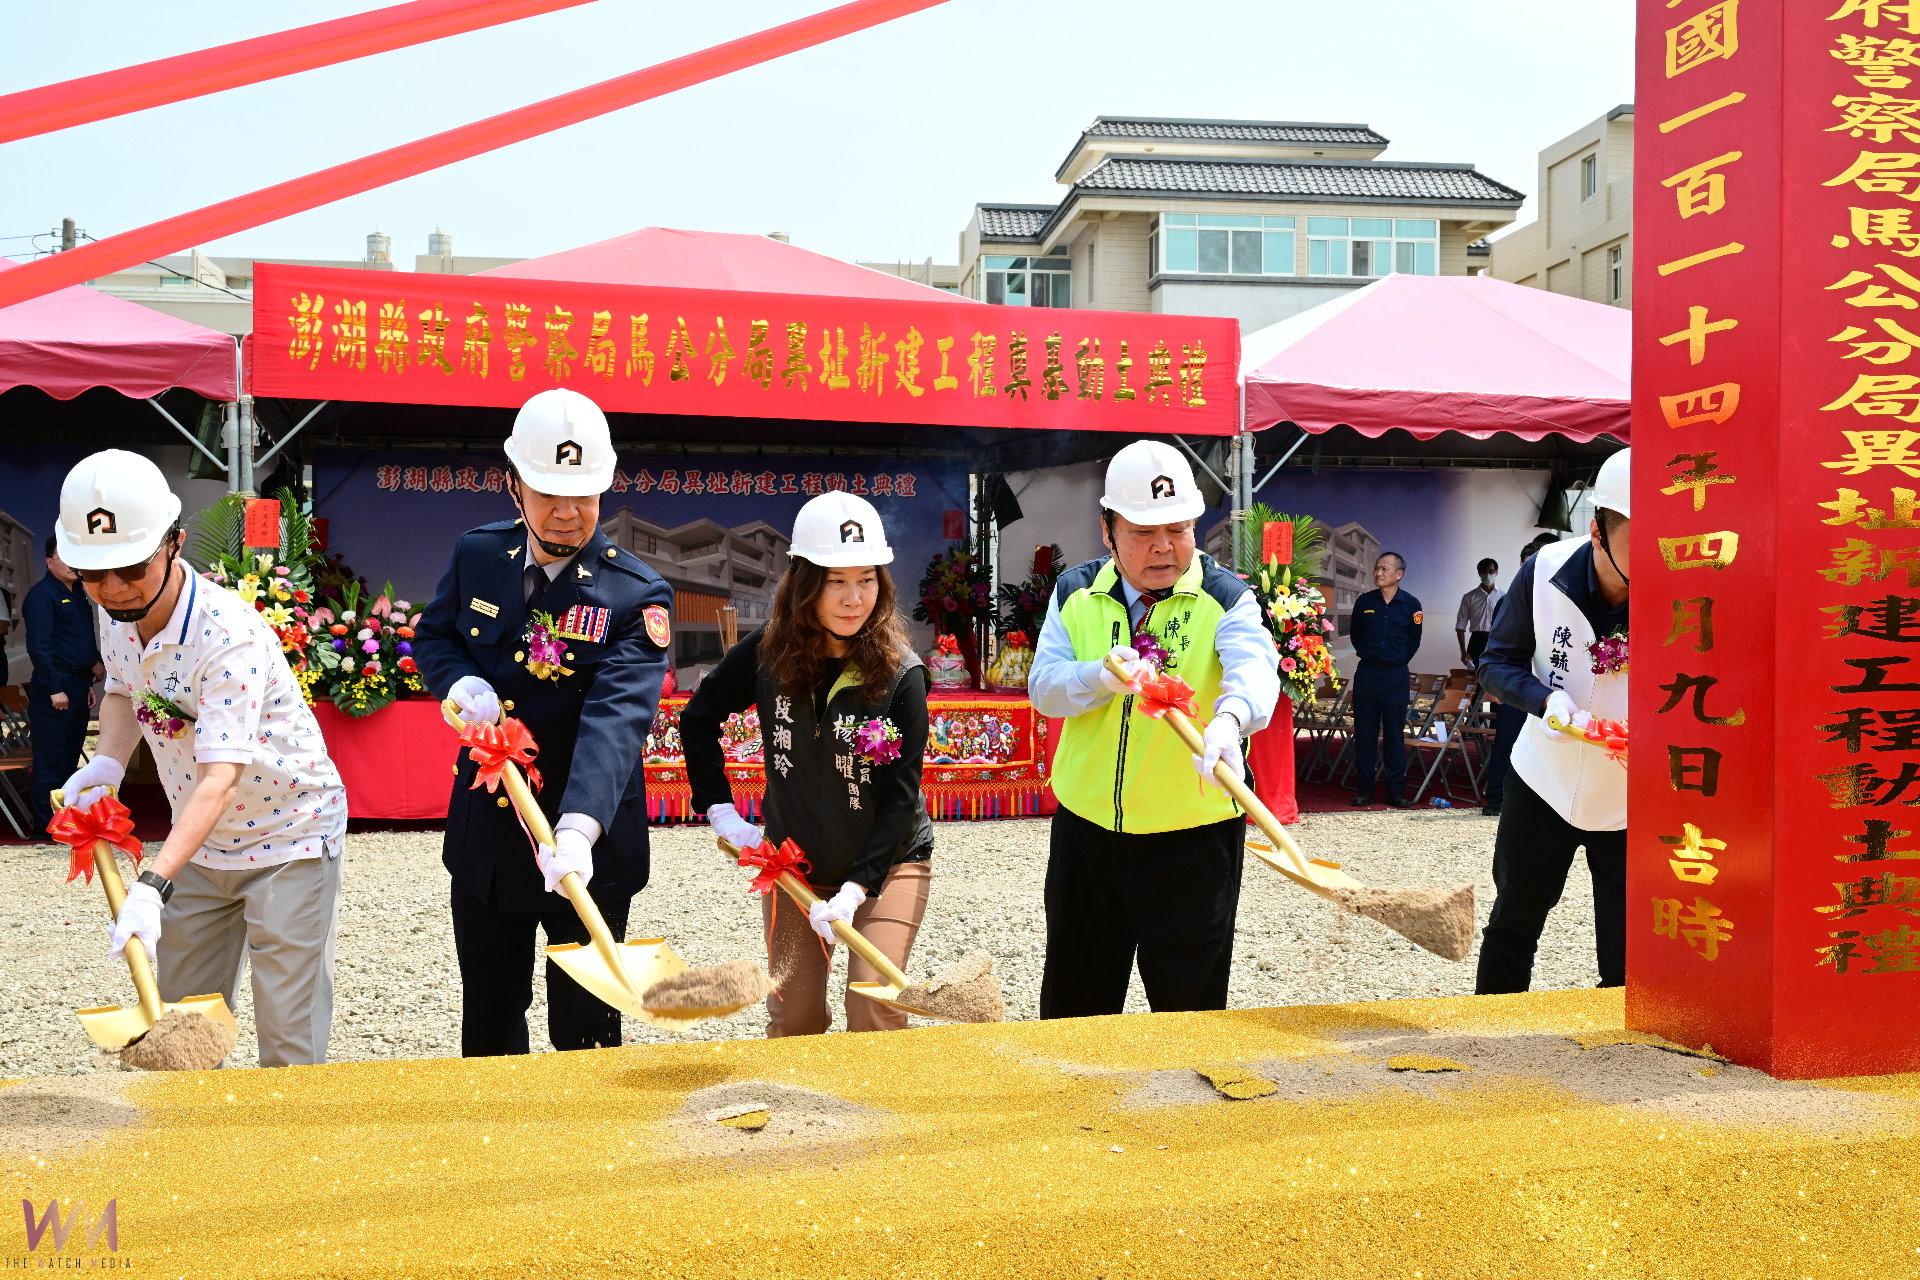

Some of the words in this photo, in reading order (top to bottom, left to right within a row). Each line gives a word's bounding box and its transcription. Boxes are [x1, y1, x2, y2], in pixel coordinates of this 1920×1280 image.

[1548, 626, 1574, 690] 陳毓仁
[1650, 0, 1748, 962] 國一百一十四年四月九日吉時
